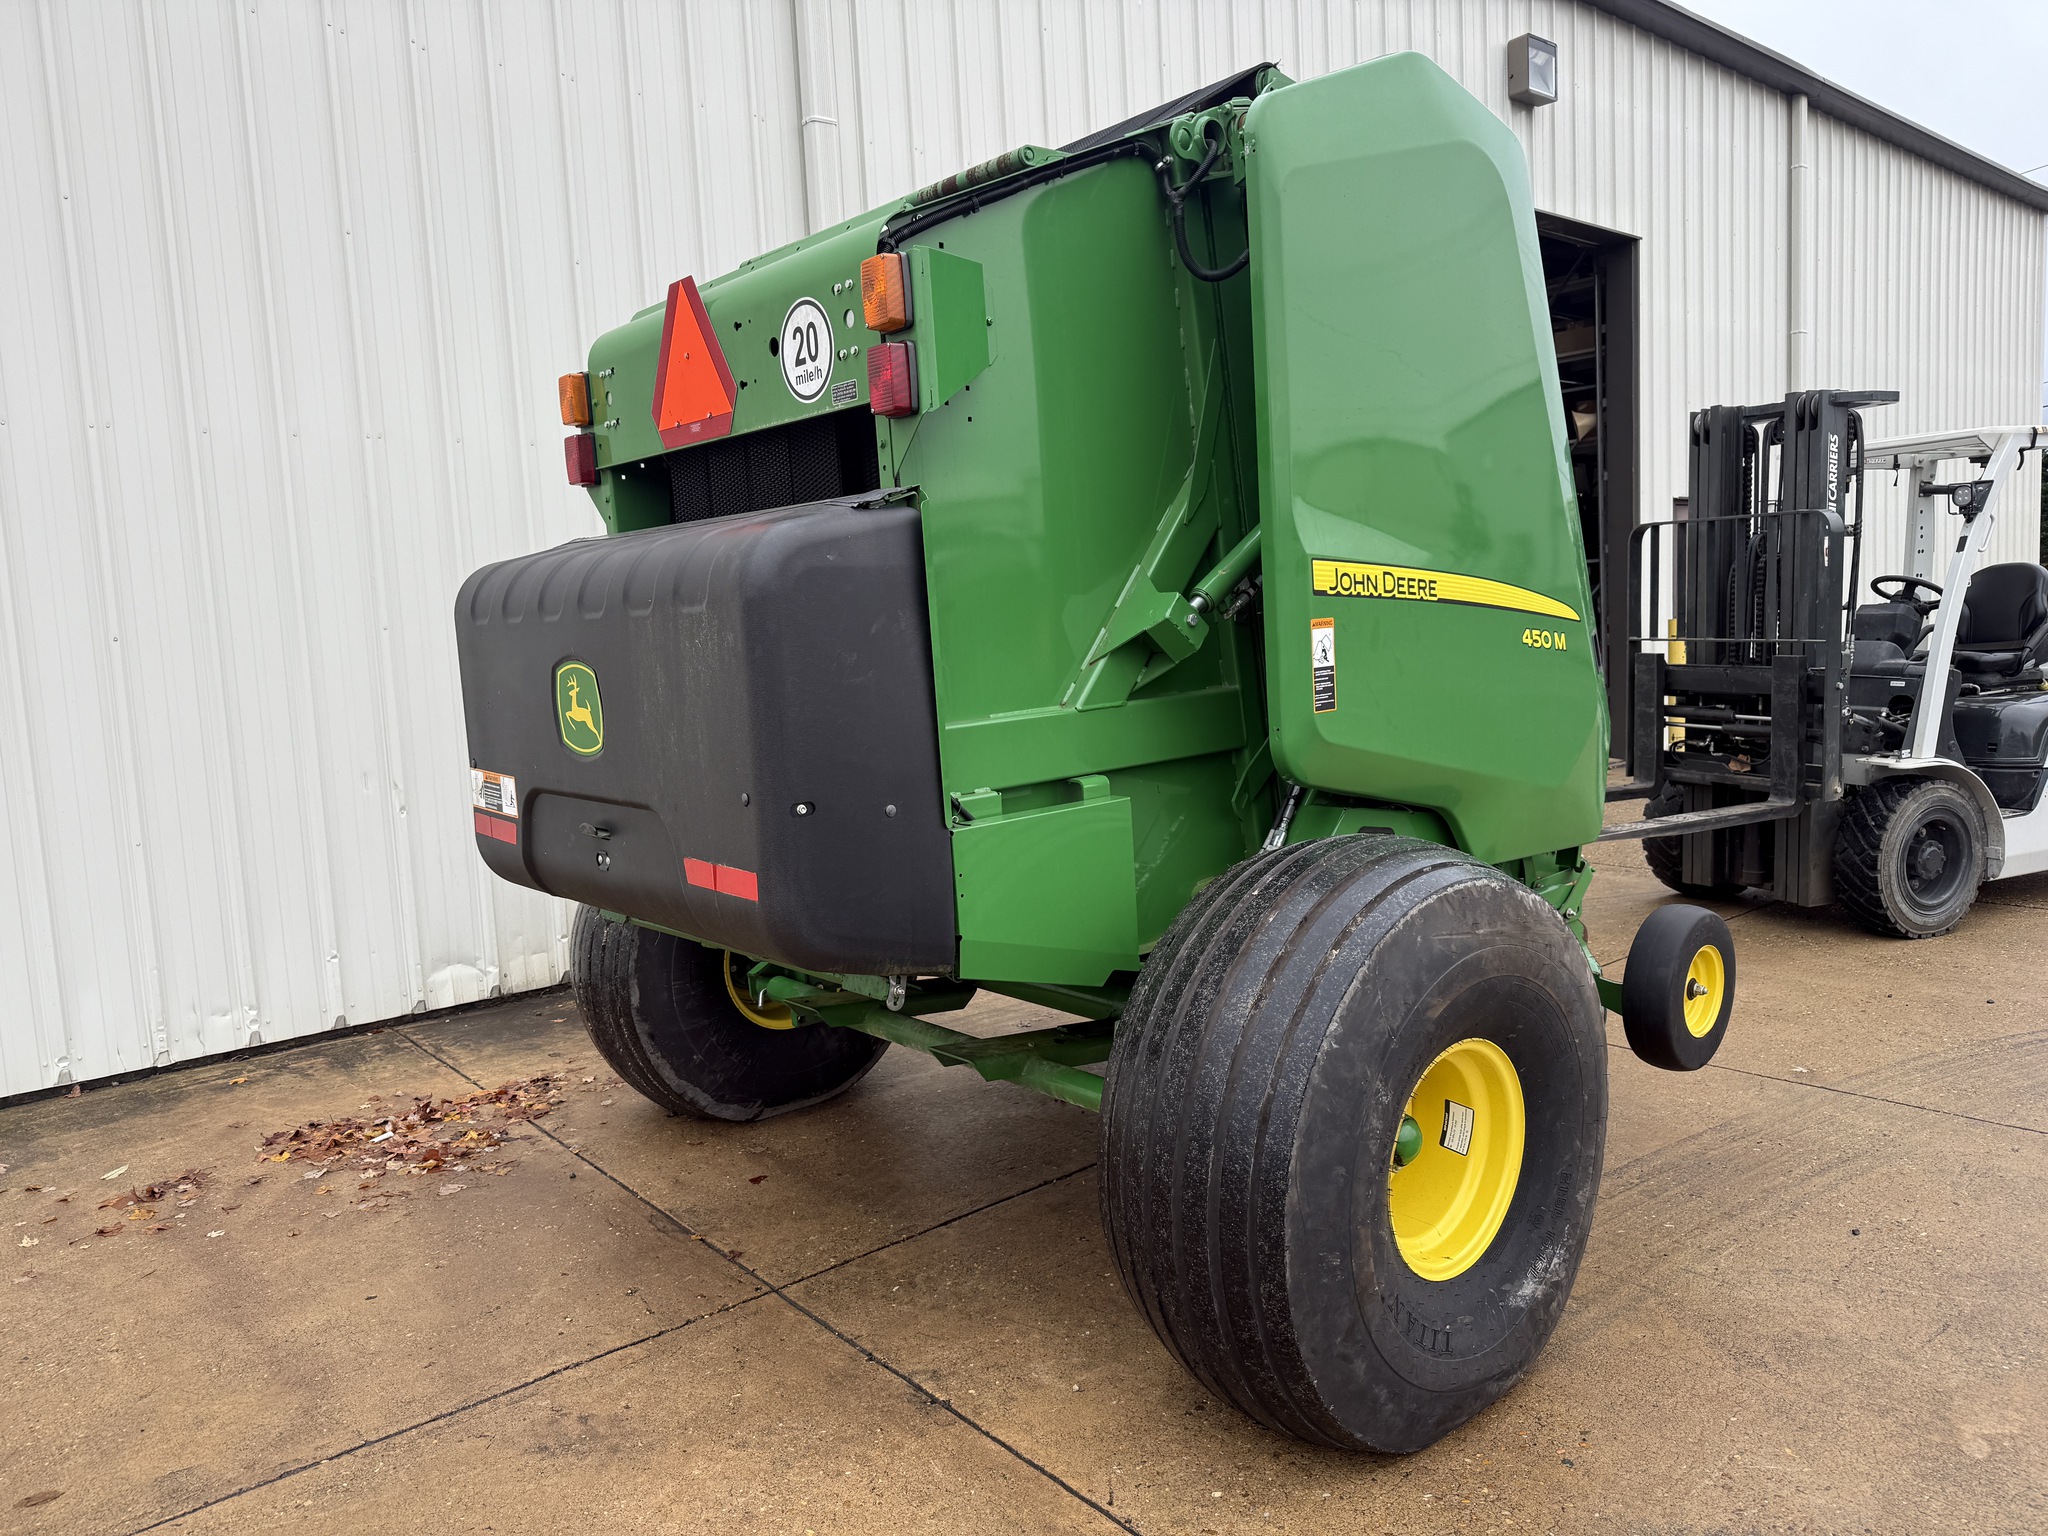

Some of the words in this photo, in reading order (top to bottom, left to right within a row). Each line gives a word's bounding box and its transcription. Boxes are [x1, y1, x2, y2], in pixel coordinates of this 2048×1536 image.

[793, 321, 819, 367] 20
[795, 366, 822, 386] mile/h
[1828, 434, 1838, 501] CARRIERS
[1329, 567, 1378, 592] JOHN
[1382, 571, 1438, 597] DEERE
[1522, 628, 1552, 650] 450
[1554, 632, 1567, 650] M
[1387, 1294, 1454, 1357] TITAN
